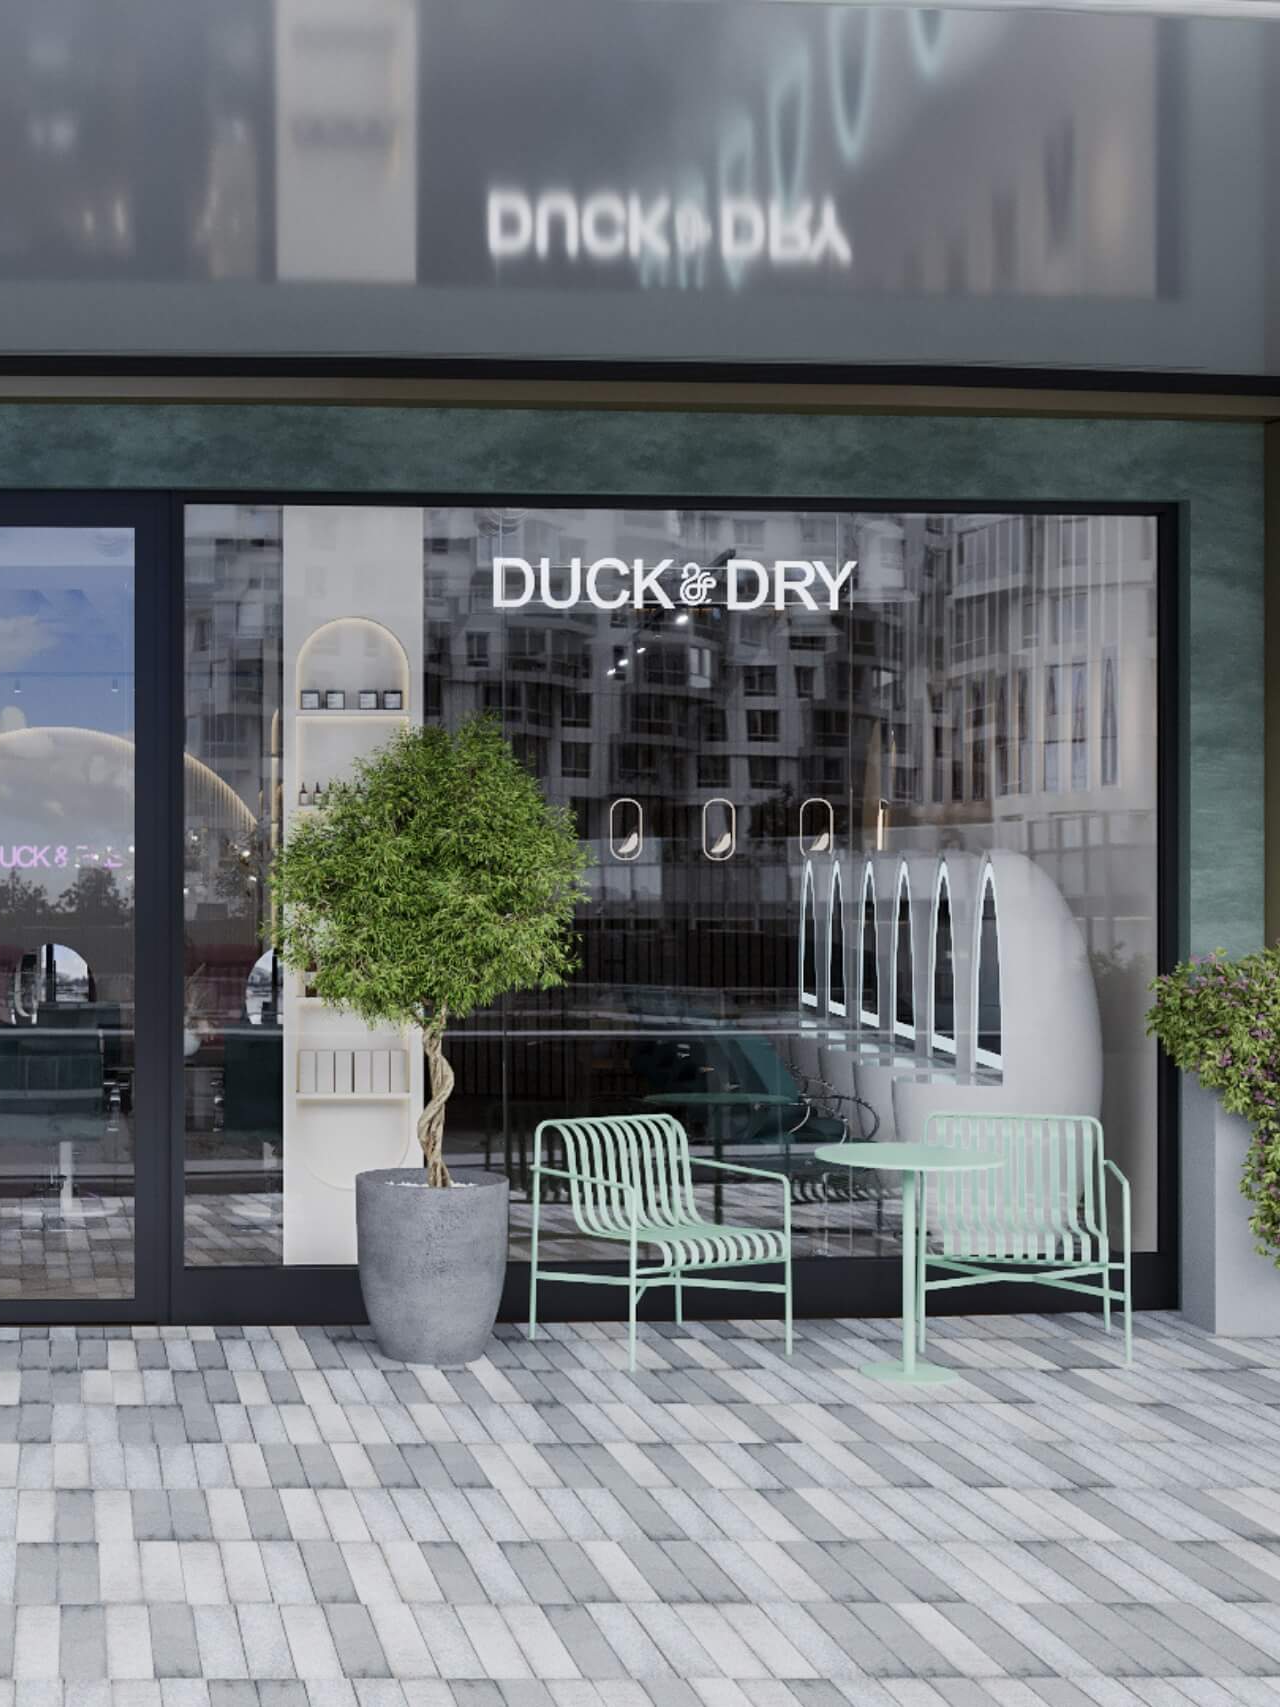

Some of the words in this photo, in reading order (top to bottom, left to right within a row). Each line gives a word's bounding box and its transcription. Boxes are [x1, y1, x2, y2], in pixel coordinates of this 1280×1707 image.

[492, 556, 675, 610] DUCK
[680, 562, 717, 606] &
[727, 560, 858, 611] DRY
[54, 845, 68, 867] &
